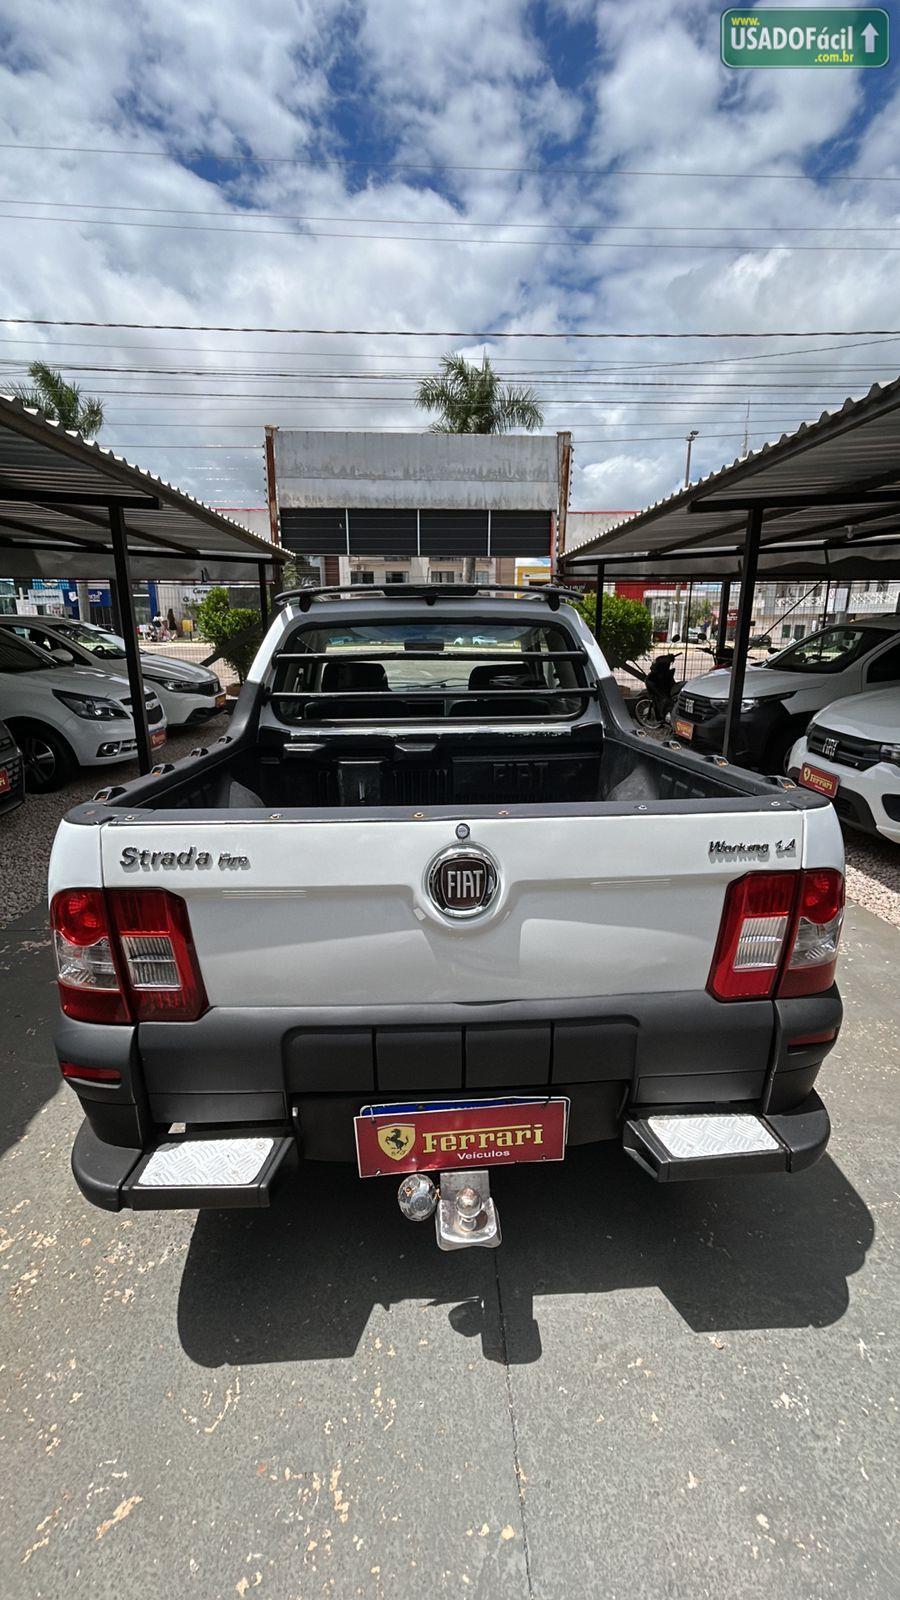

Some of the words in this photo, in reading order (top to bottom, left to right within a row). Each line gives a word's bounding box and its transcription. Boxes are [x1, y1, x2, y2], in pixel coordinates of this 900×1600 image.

[119, 846, 210, 871] Strada
[447, 870, 483, 898] FIAT
[422, 1124, 543, 1153] Ferrari
